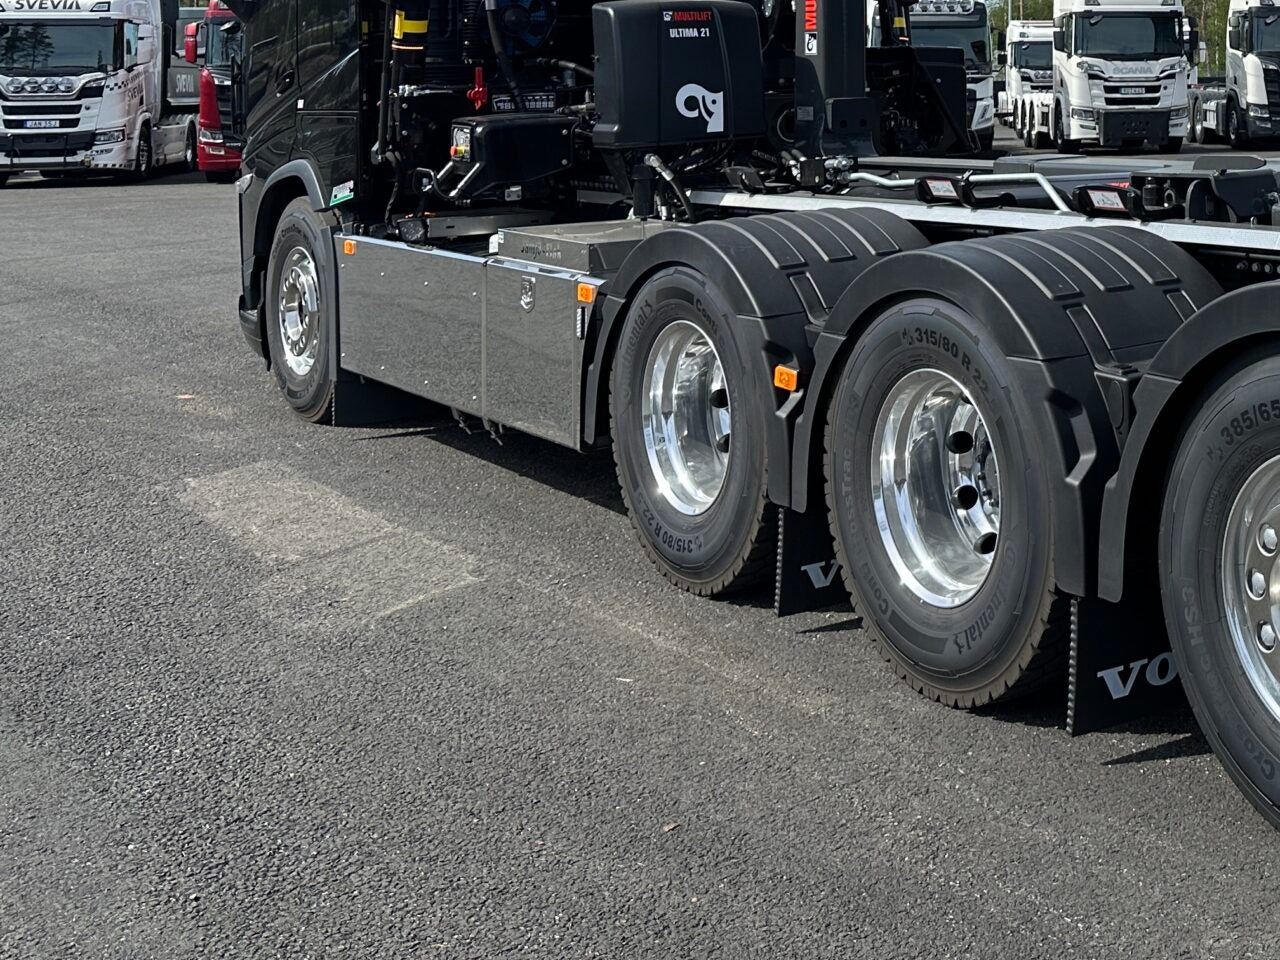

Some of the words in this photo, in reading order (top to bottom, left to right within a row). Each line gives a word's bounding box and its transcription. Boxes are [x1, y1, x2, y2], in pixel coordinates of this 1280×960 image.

[14, 0, 81, 10] SVEVIA
[673, 11, 712, 21] MULTILIFT
[669, 27, 699, 38] ULTIMA
[700, 27, 710, 37] 21
[1112, 66, 1154, 75] SCANIA
[176, 73, 195, 93] SVEVIA
[914, 327, 960, 359] 315/80
[961, 351, 971, 371] R
[654, 522, 662, 539] R
[662, 530, 694, 554] 315/80
[1097, 651, 1176, 700] VO
